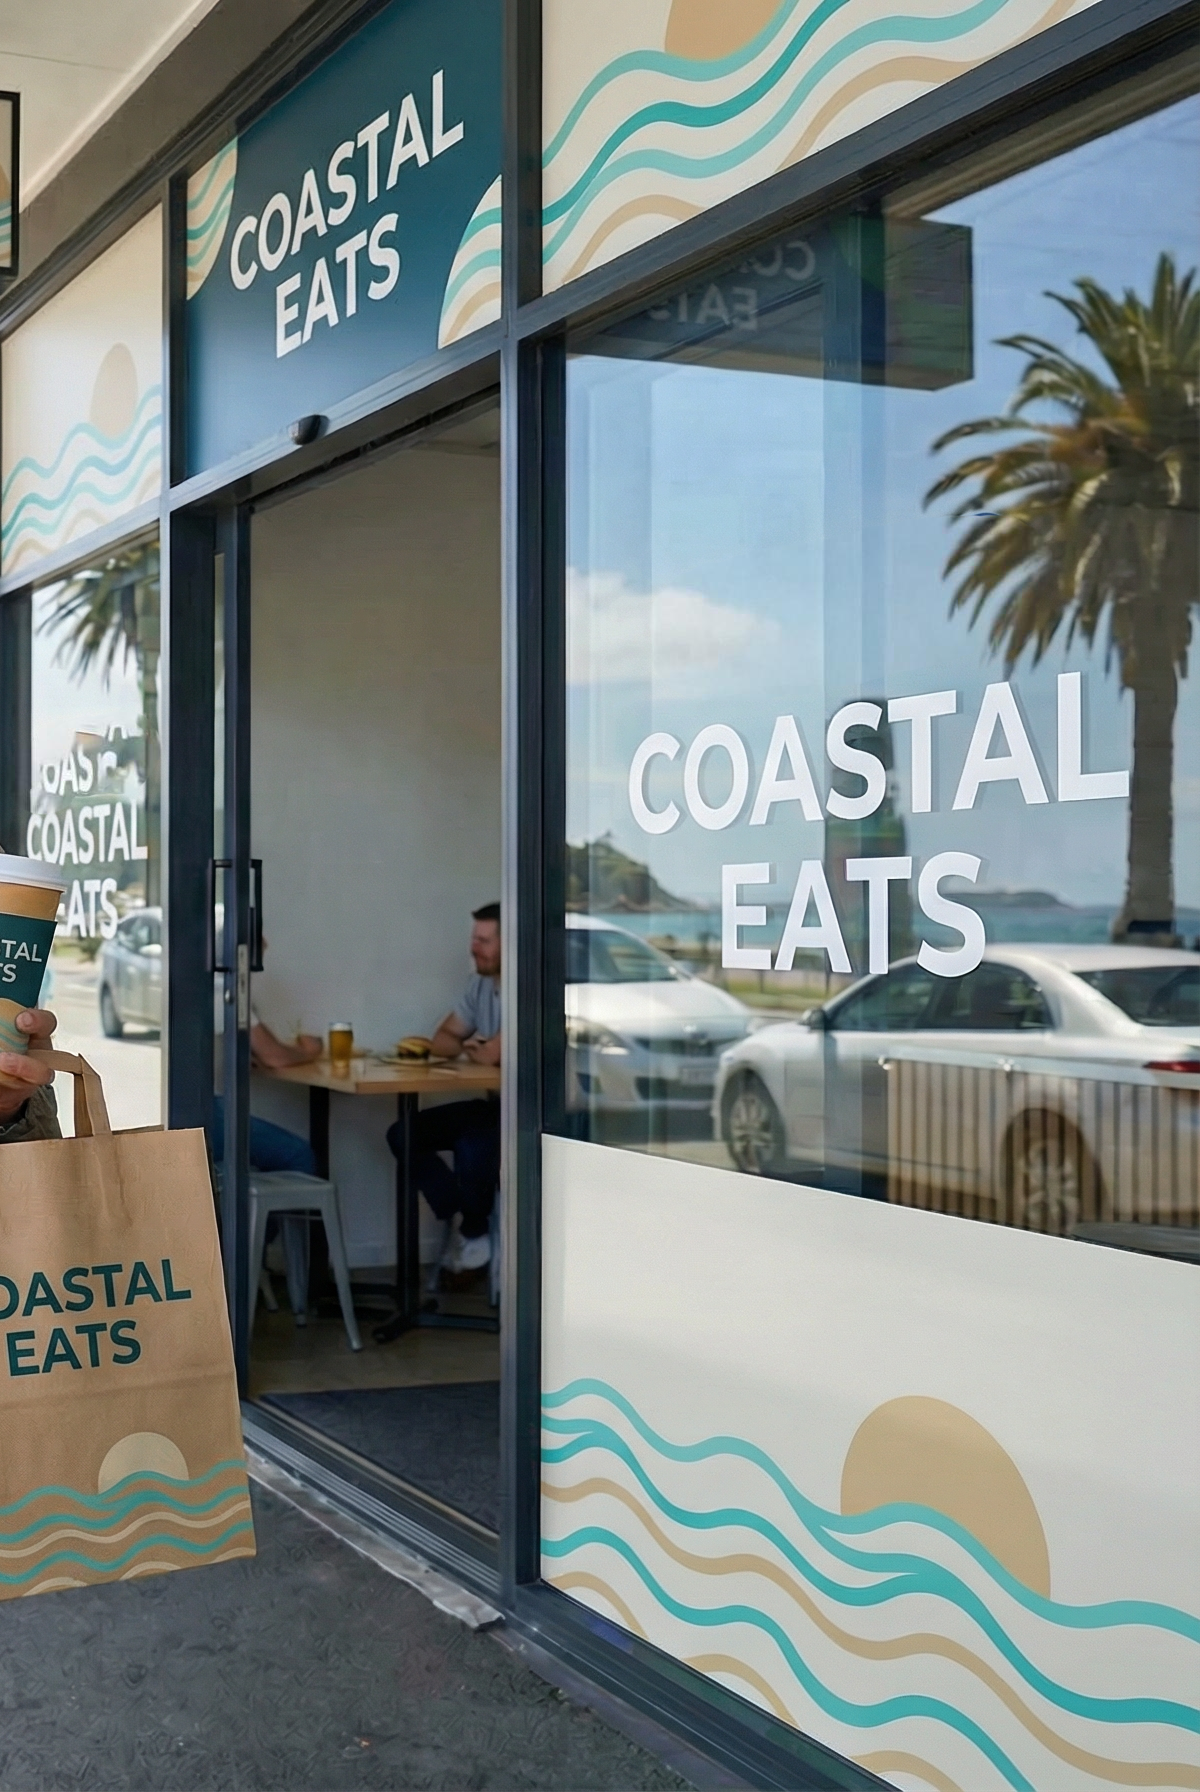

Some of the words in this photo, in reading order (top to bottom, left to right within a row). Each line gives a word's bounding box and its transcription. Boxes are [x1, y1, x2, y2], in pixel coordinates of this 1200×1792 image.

[230, 69, 464, 290] COASTAL
[275, 214, 401, 359] EATS
[628, 671, 1129, 834] COASTAL
[26, 800, 148, 865] COASTAL
[721, 851, 986, 978] EATS
[6, 1320, 141, 1377] EATS
